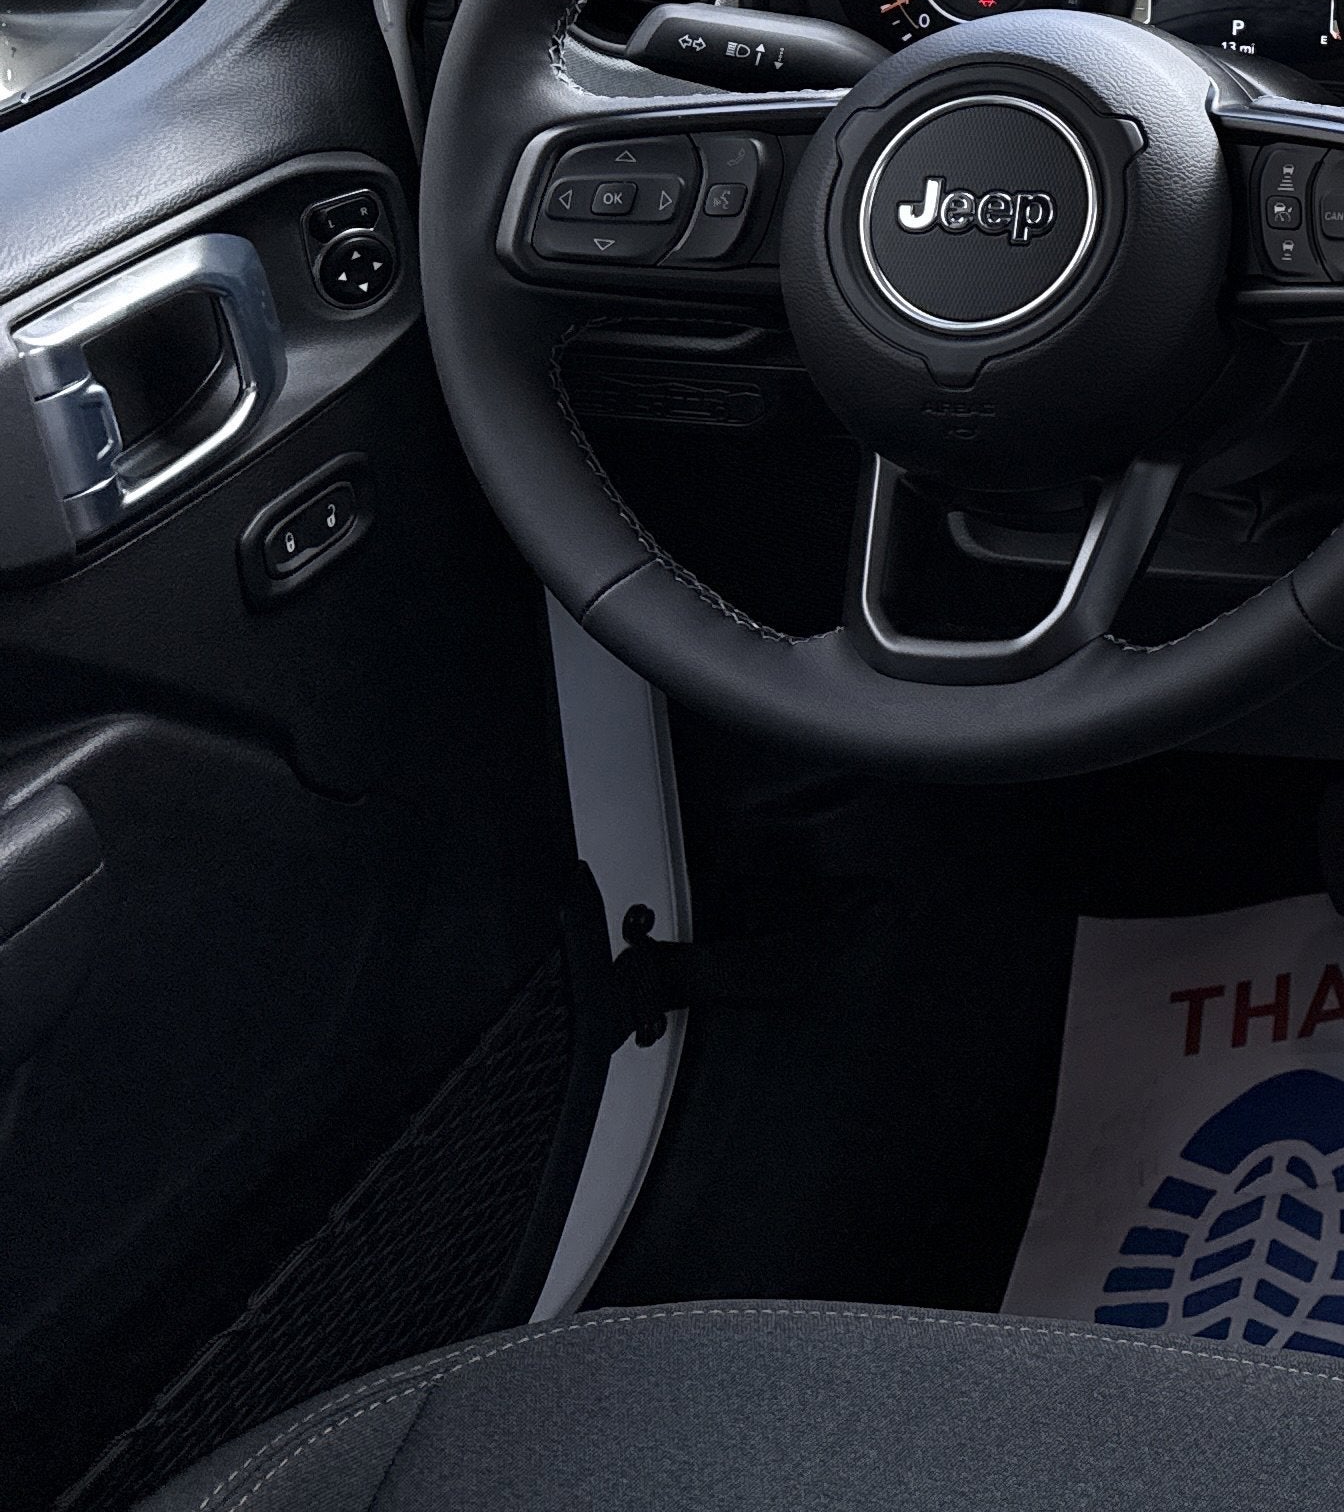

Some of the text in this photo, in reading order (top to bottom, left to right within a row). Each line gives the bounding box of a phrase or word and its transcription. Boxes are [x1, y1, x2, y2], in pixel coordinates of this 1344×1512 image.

[918, 13, 930, 28] 0
[1231, 19, 1245, 36] P
[601, 192, 625, 206] OK
[897, 177, 1057, 246] Jeep
